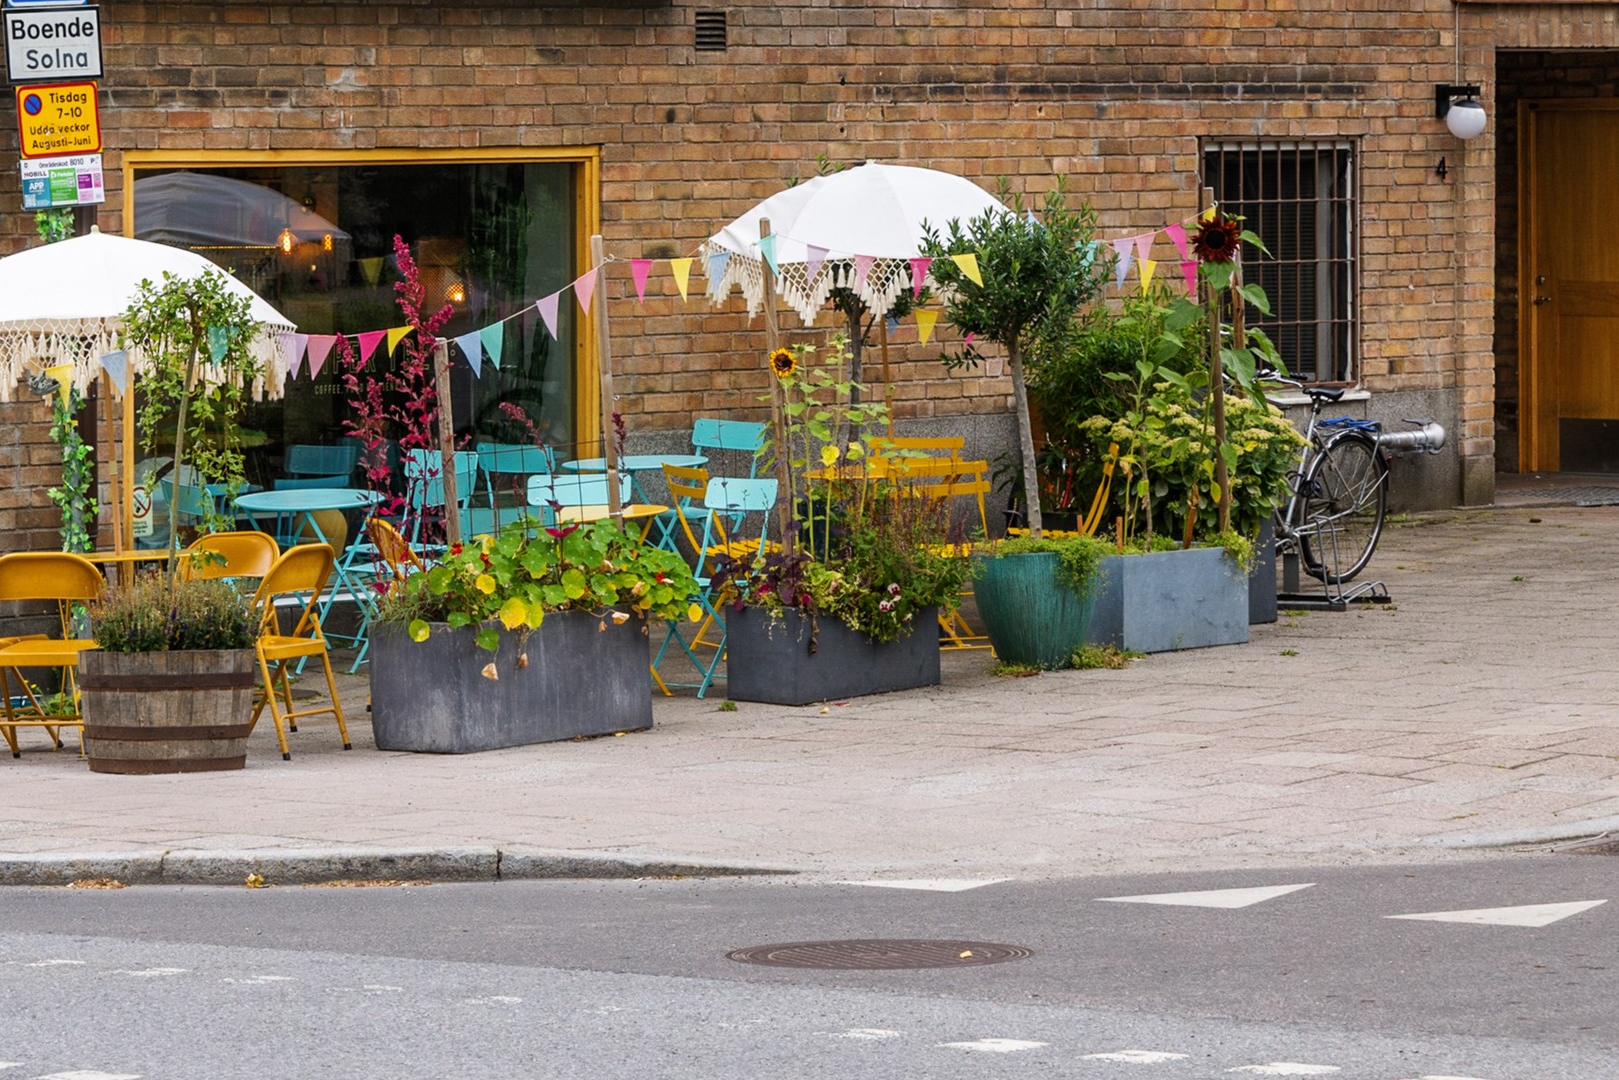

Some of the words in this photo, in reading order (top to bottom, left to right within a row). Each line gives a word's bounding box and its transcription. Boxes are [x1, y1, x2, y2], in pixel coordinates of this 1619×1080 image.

[11, 16, 94, 40] Boende
[26, 48, 88, 70] Solna
[49, 92, 87, 104] Tisdag
[56, 107, 83, 119] 7-10
[30, 125, 55, 136] Udda
[58, 123, 90, 134] veckor
[32, 136, 91, 150] Augusti-Juni
[1437, 156, 1448, 180] 4
